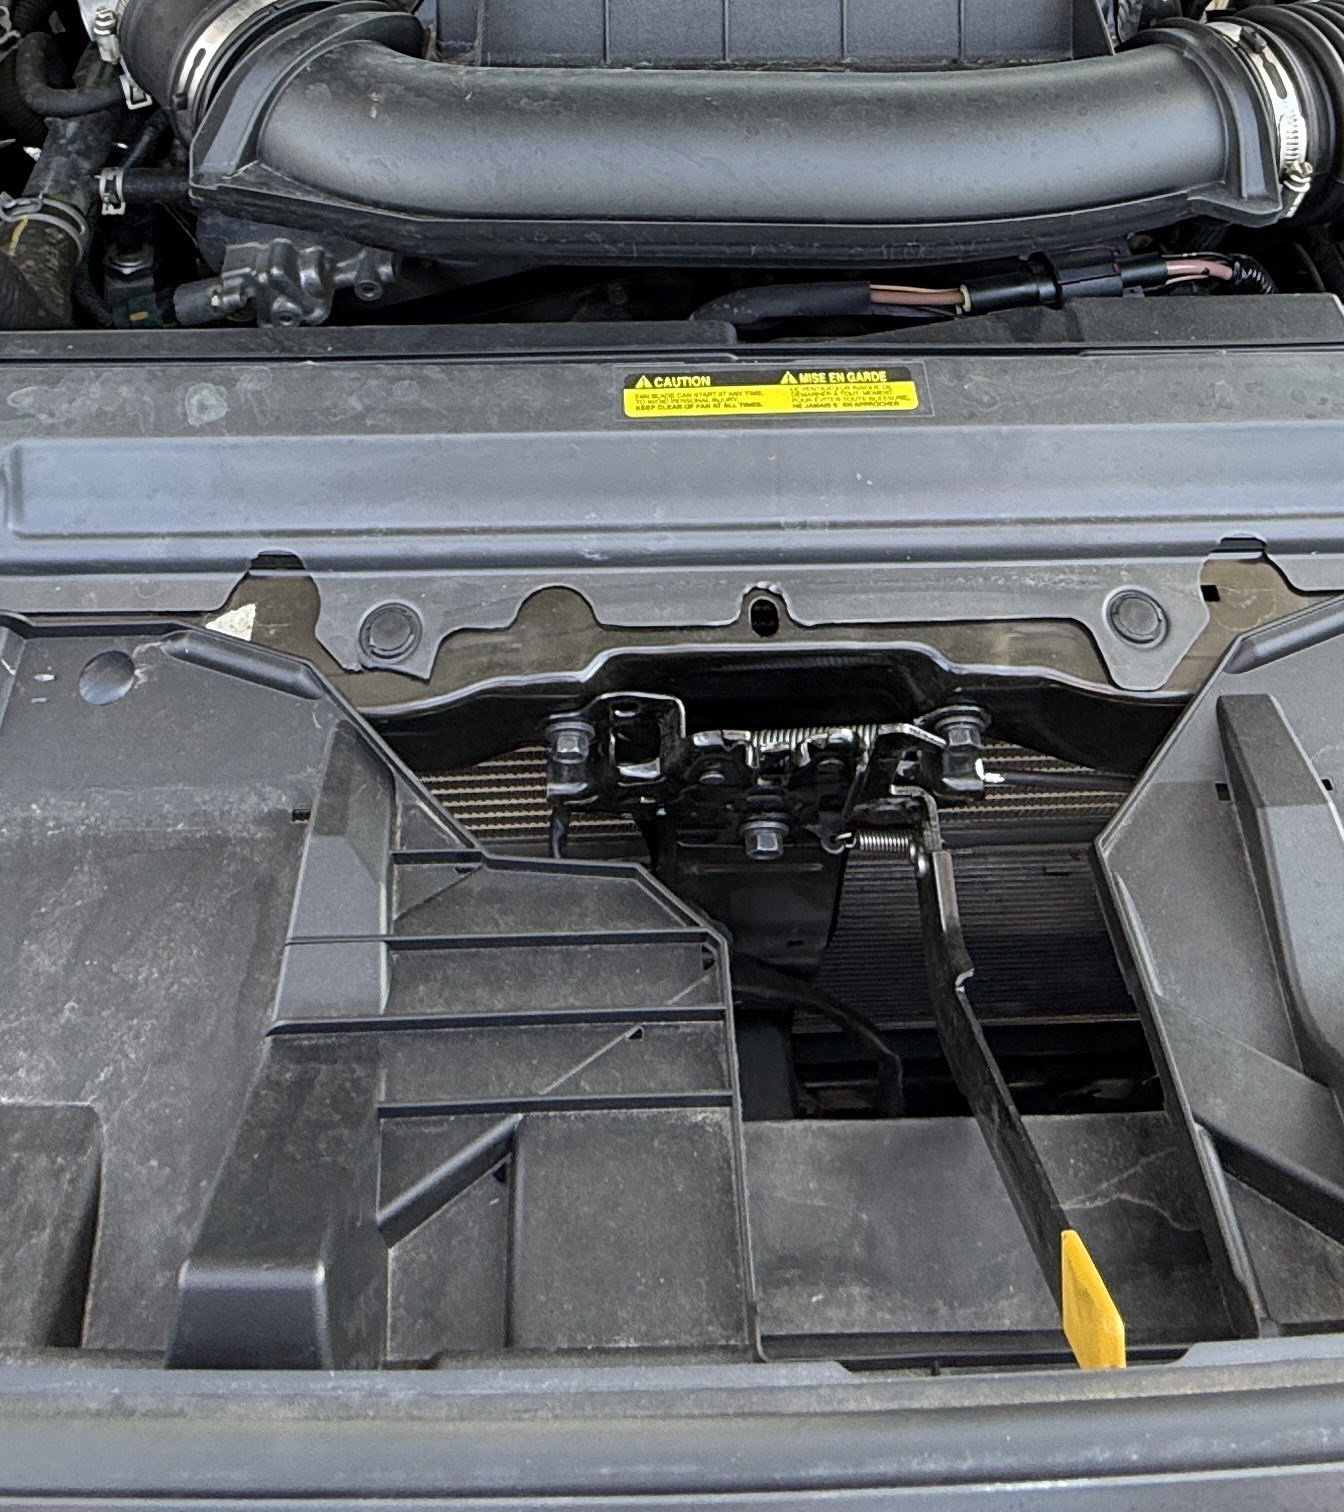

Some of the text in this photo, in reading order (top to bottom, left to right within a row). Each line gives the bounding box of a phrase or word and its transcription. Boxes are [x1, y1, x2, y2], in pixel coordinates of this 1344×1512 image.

[654, 376, 711, 387] CAUTION
[799, 371, 887, 383] MISE EN GARDE
